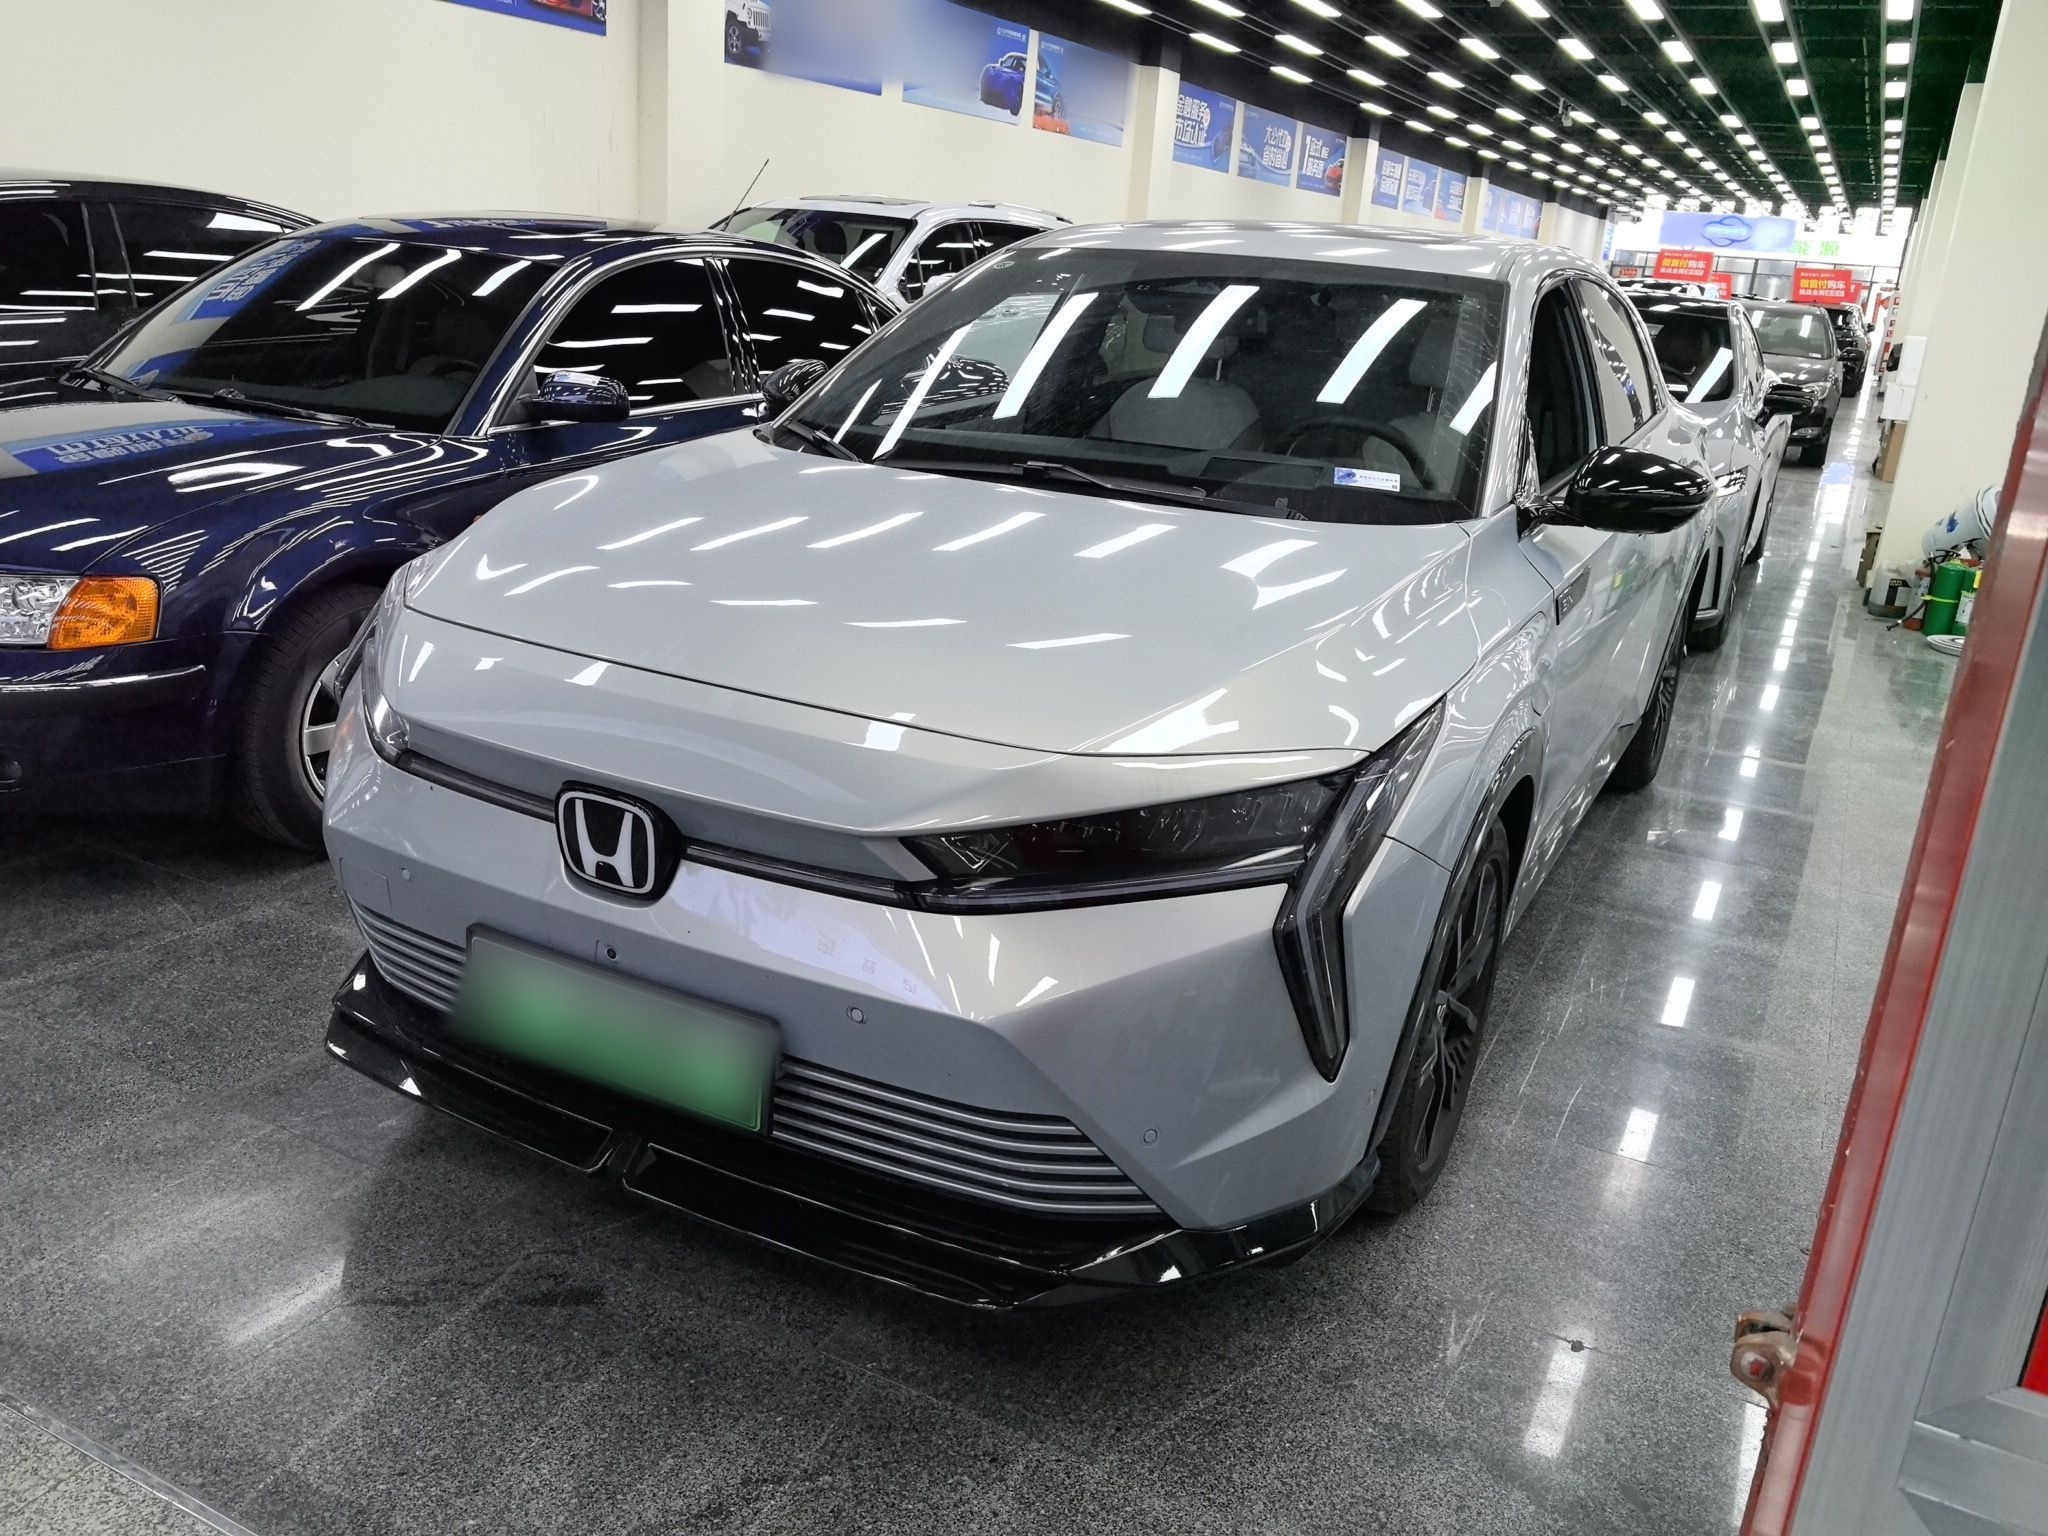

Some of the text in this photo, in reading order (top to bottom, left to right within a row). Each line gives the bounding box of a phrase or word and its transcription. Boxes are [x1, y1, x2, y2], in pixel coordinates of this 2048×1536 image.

[1177, 95, 1208, 121] 金融服务
[1176, 119, 1207, 145] 市场认证
